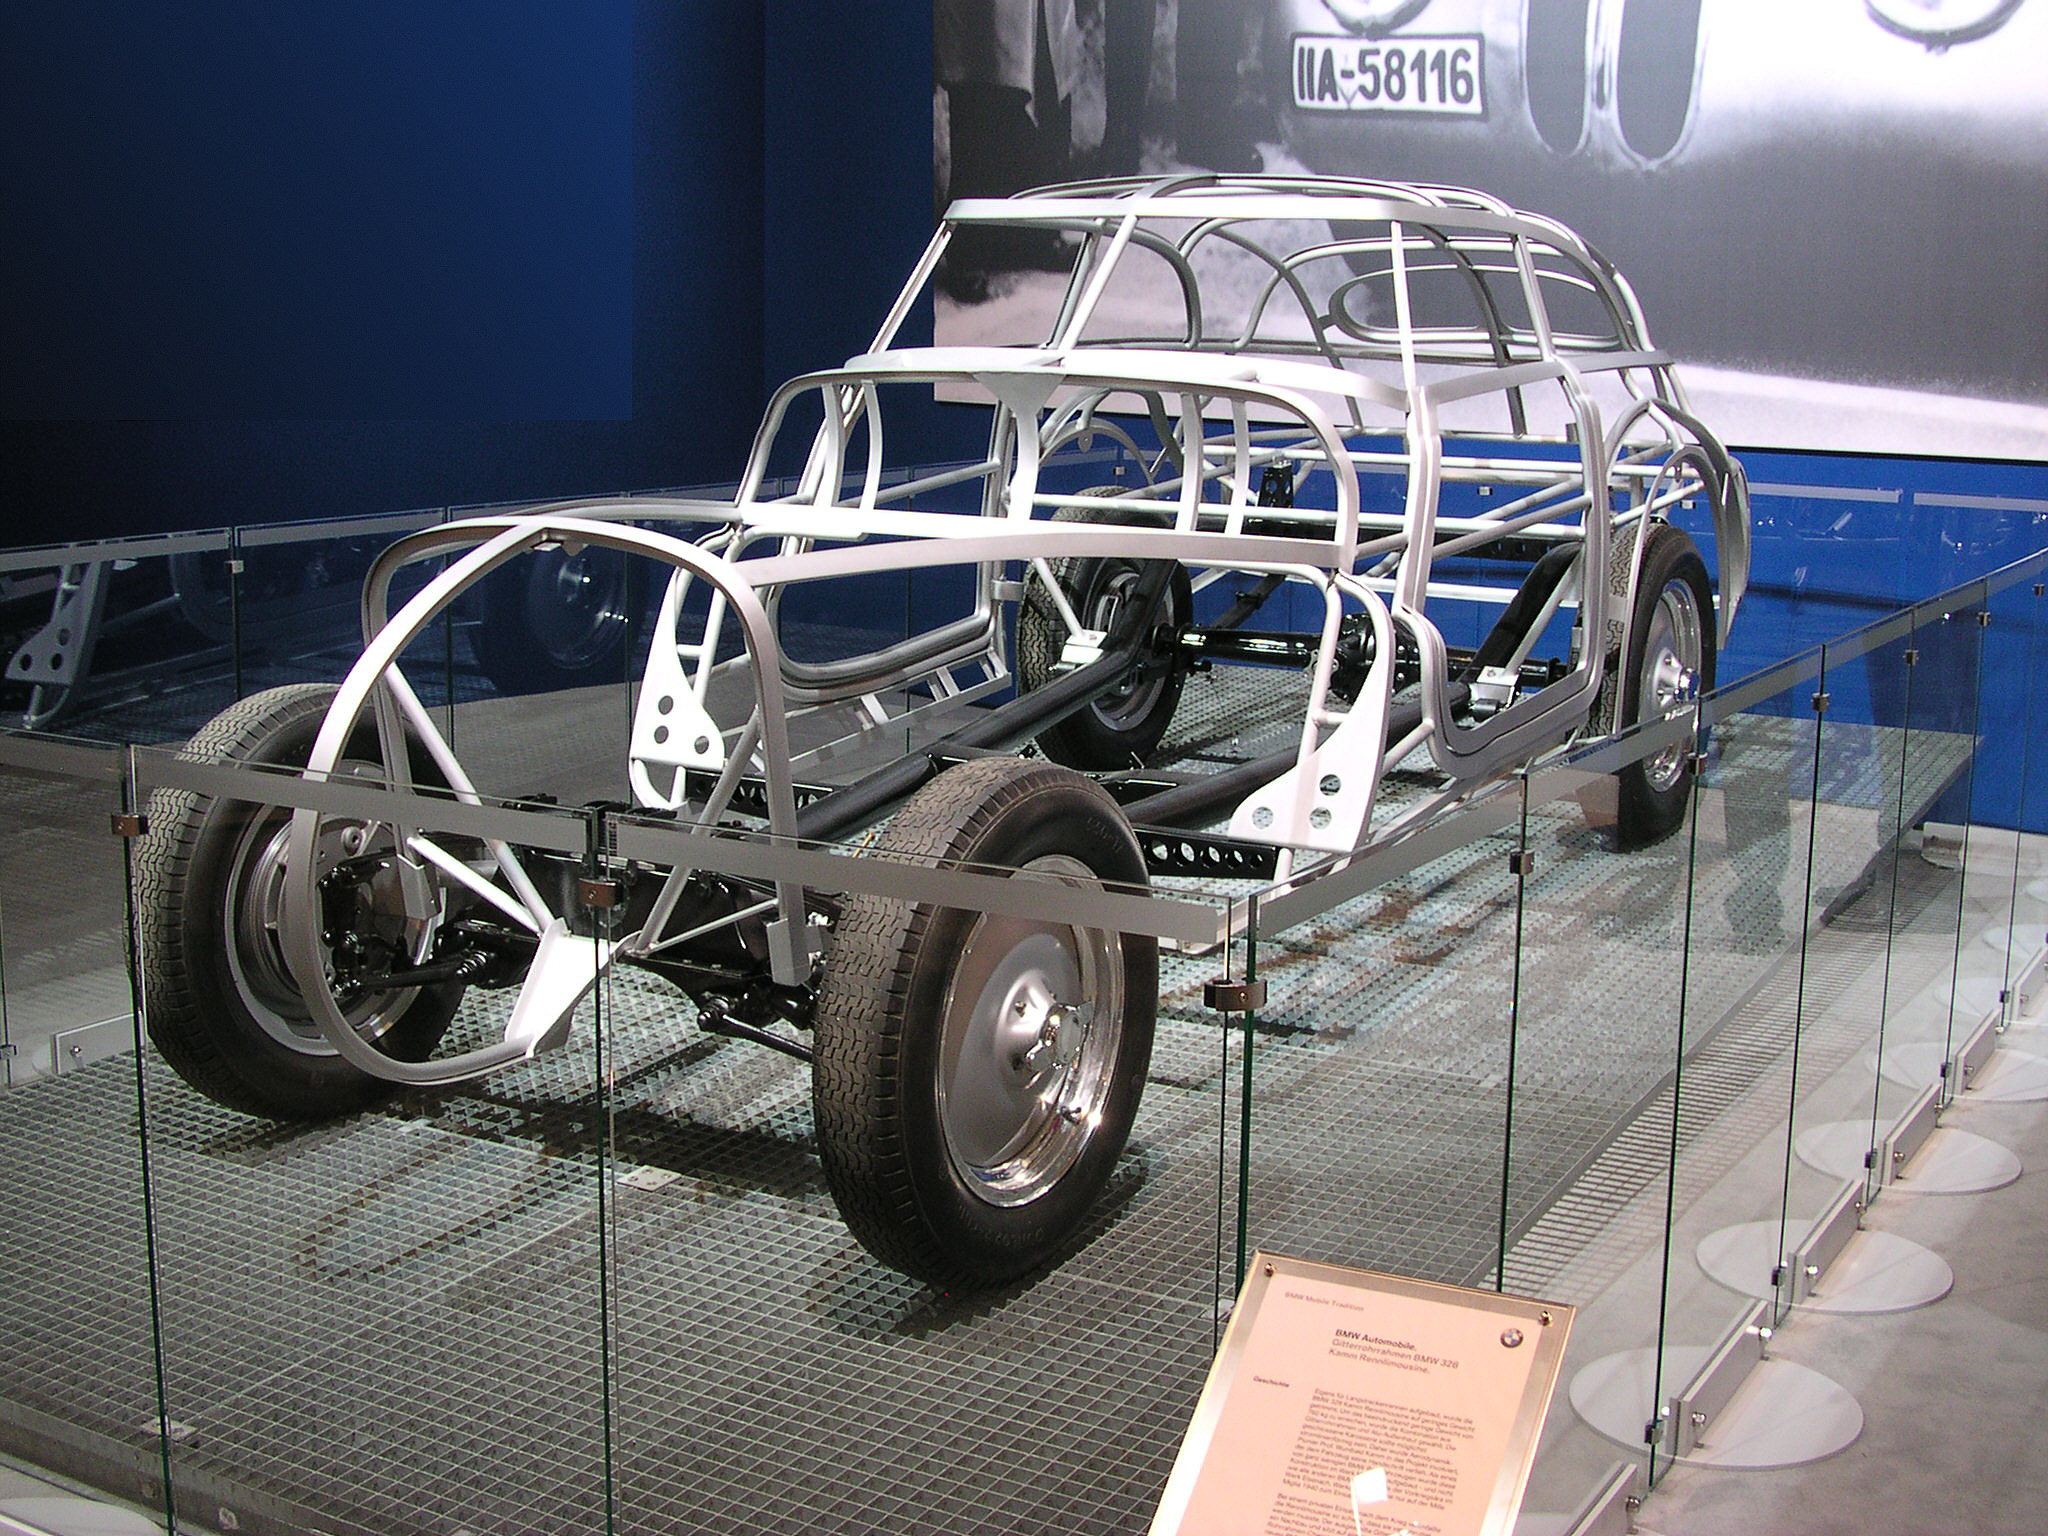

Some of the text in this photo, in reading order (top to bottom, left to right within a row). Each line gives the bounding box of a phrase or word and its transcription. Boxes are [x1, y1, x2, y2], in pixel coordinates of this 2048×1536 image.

[1297, 46, 1474, 105] IIA-58116
[1284, 1291, 1365, 1312] BMW Mobile Tradition
[1334, 1328, 1417, 1351] BMW Automobile.
[1328, 1348, 1358, 1360] Kamm
[1331, 1338, 1412, 1361] Gitterrohrrahmen
[1413, 1353, 1440, 1365] BMW
